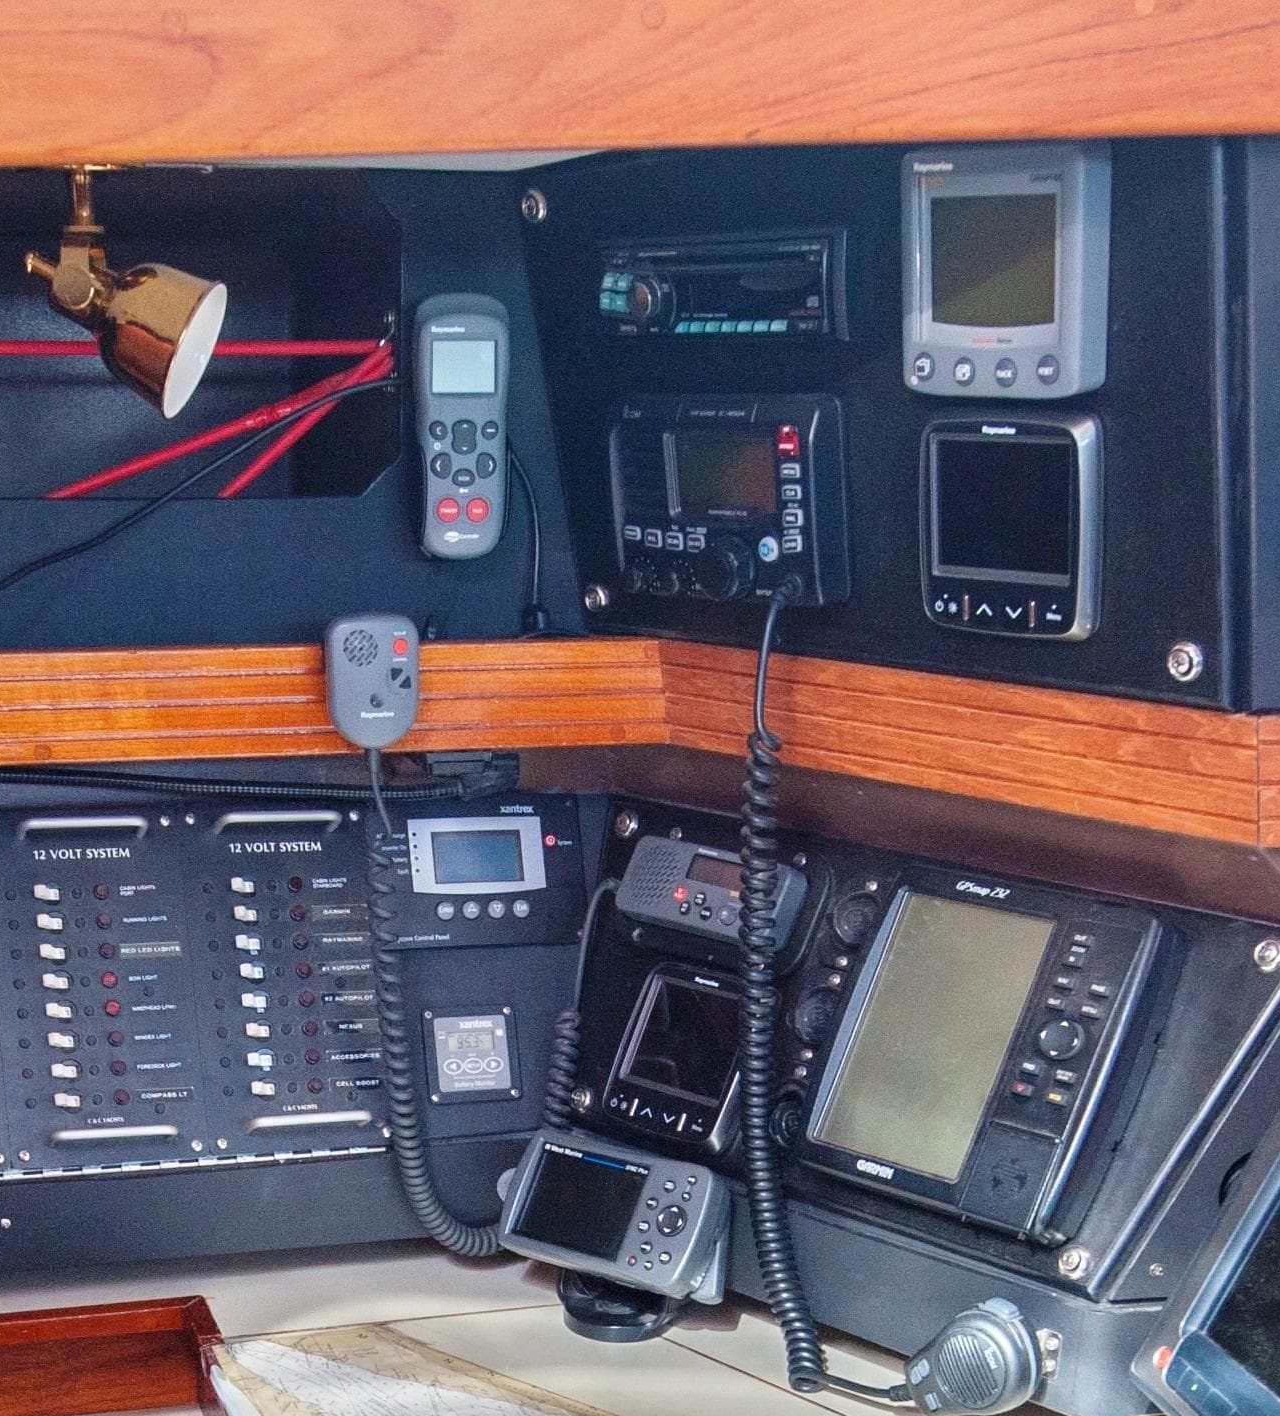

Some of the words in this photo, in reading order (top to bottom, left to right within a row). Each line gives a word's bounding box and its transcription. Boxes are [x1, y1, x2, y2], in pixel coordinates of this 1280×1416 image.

[229, 844, 241, 853] 12
[245, 842, 275, 852] VOLT
[279, 842, 321, 852] SYSTEM
[33, 851, 46, 860] 12
[49, 849, 82, 860] VOLT
[86, 848, 130, 859] SYSTEM
[857, 1159, 893, 1180] GARMIN
